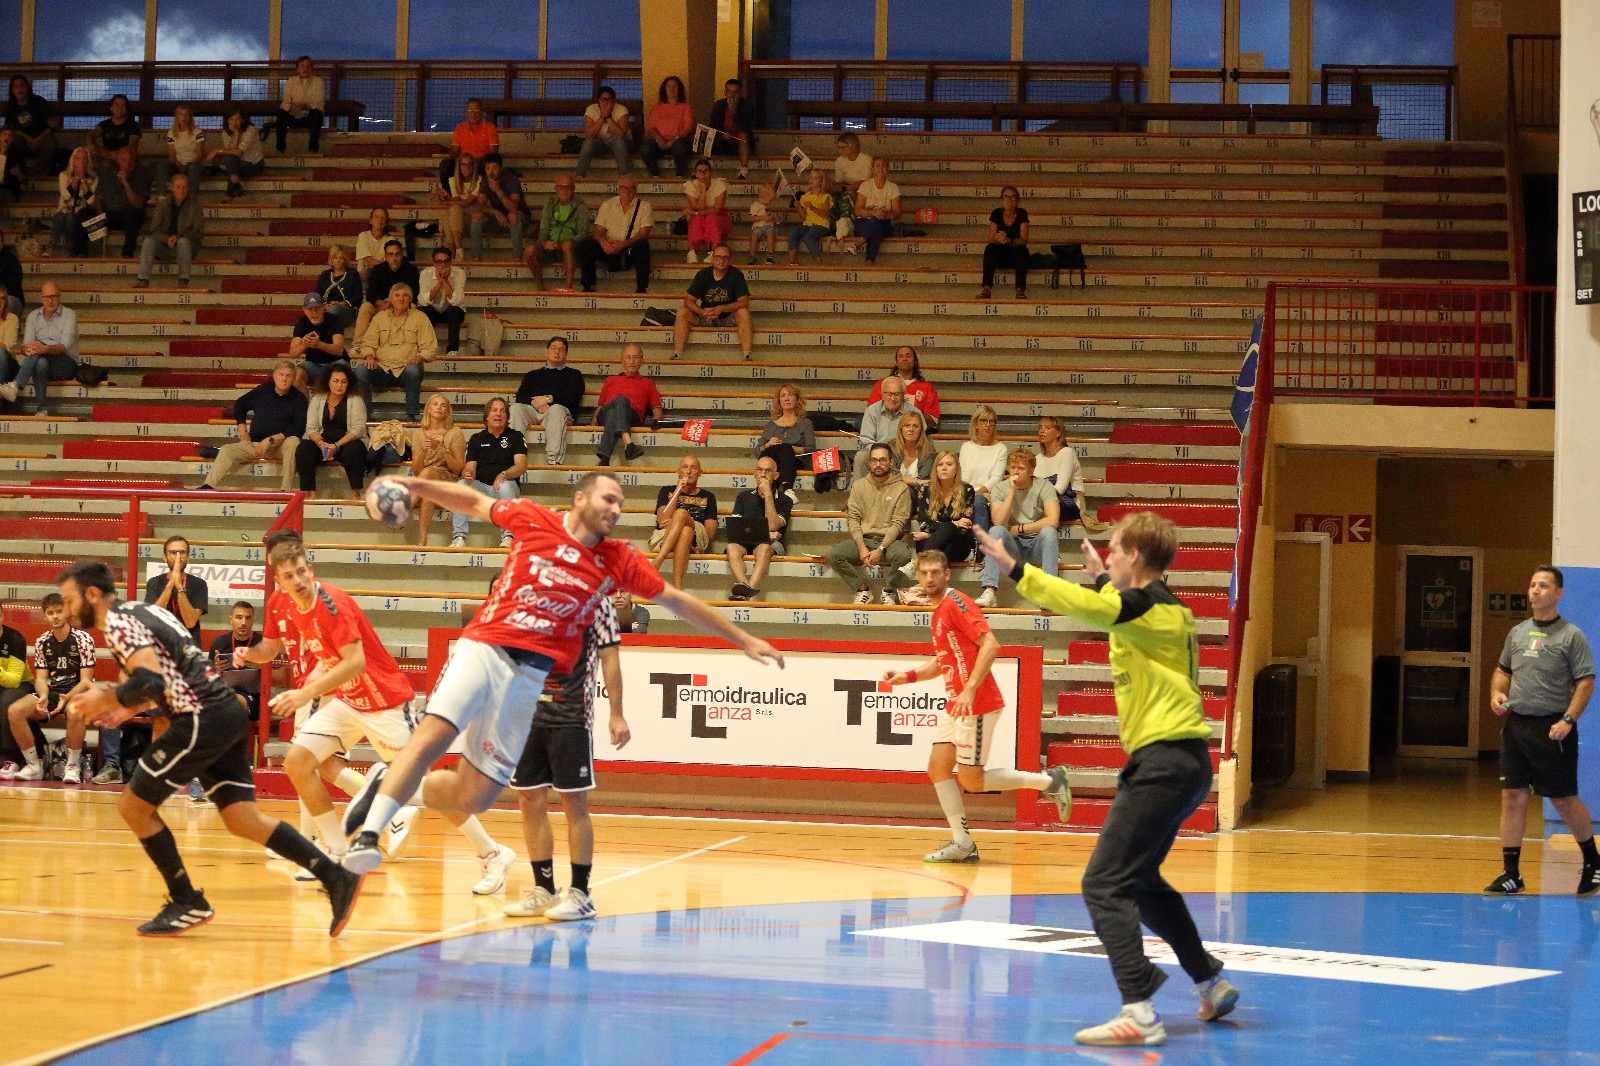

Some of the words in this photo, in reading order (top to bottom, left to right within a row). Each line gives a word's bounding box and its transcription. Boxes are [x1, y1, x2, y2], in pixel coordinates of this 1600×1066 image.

[1576, 288, 1593, 300] SET
[212, 359, 223, 368] IX
[598, 365, 609, 374] 57
[712, 400, 725, 409] 51
[1179, 408, 1196, 419] VIII
[137, 425, 149, 436] VII
[1175, 446, 1189, 457] VII
[107, 461, 118, 471] VI
[732, 476, 747, 487] 52
[1169, 486, 1182, 497] VI
[79, 501, 84, 511] V
[168, 503, 182, 514] 42
[328, 507, 343, 518] 45
[827, 520, 842, 531] 54
[43, 543, 54, 553] IV
[246, 548, 260, 559] 44
[356, 552, 370, 563] 46
[555, 544, 582, 564] 13
[411, 554, 426, 566] 47
[469, 555, 483, 567] 48
[809, 564, 824, 577] 54
[8, 587, 17, 598] III
[384, 599, 399, 610] 47
[442, 600, 457, 612] 48
[793, 611, 809, 623] 54
[853, 613, 869, 625] 55
[913, 613, 929, 626] 56
[1034, 618, 1049, 631] 58
[400, 646, 407, 658] II
[57, 656, 67, 669] 28
[650, 673, 807, 719] Termoidraulica
[834, 679, 947, 726] Termoidra
[691, 705, 752, 738] Lanza
[876, 711, 938, 745] Lanza
